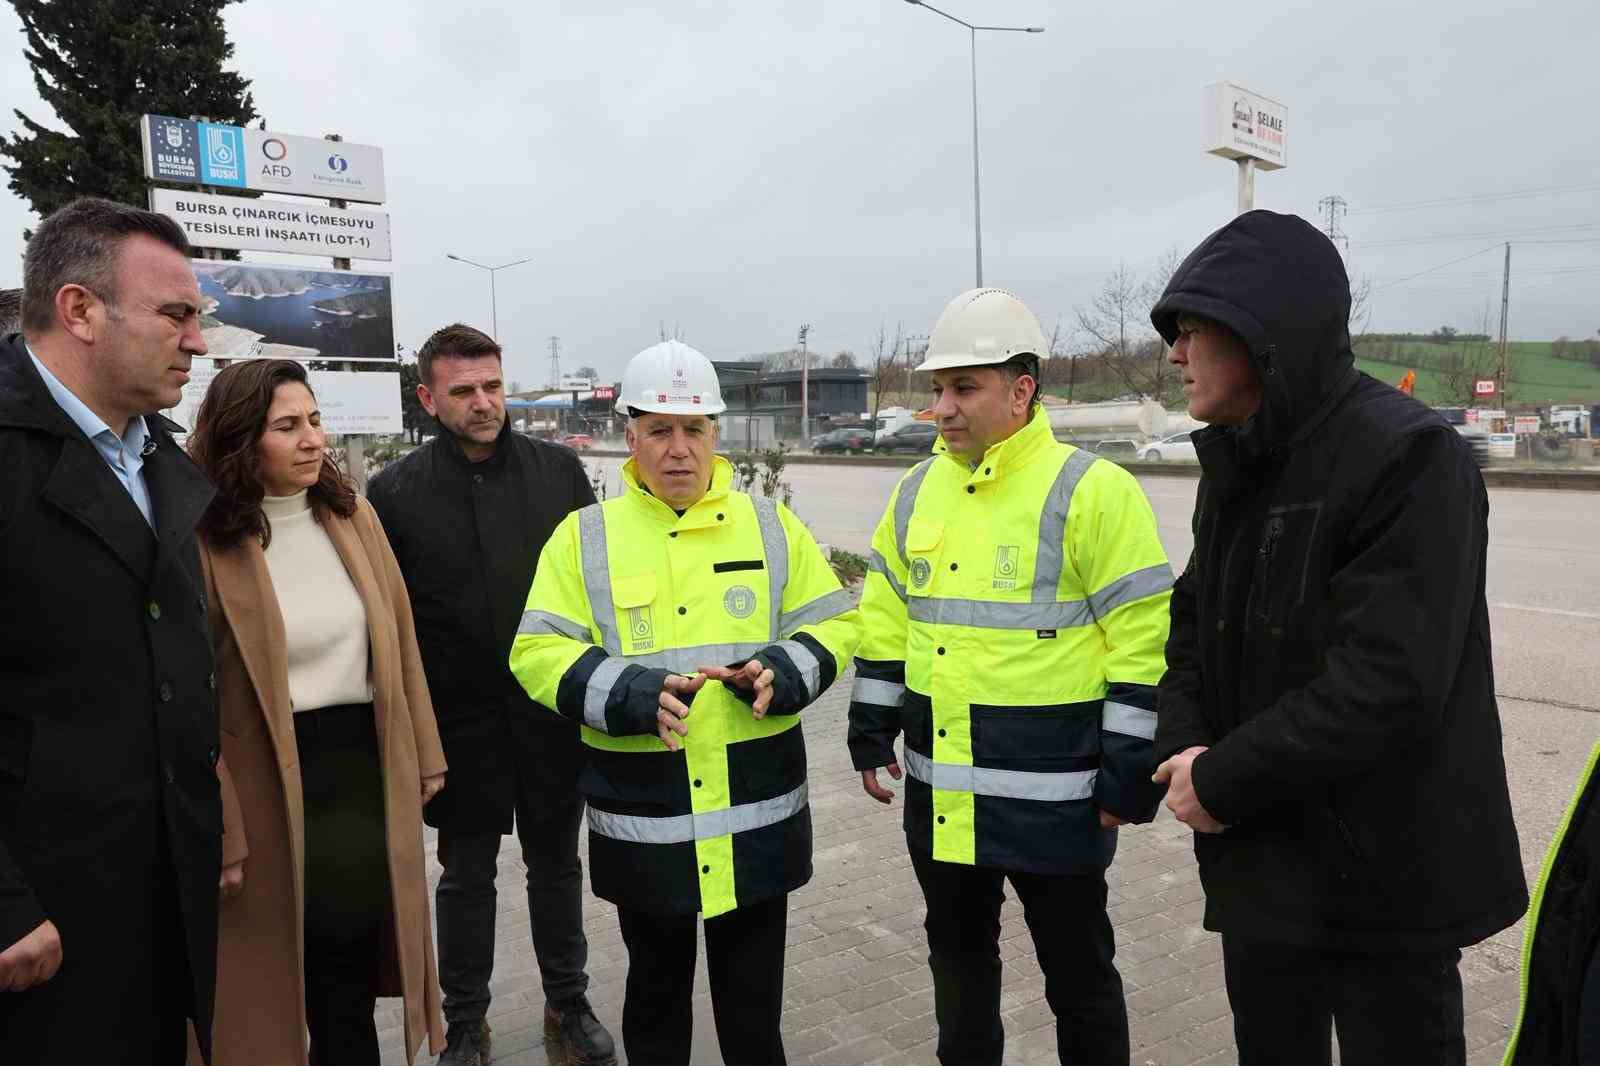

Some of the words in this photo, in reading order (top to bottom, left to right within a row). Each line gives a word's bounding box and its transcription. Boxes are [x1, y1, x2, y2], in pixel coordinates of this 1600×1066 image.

[158, 154, 194, 165] BURSA
[262, 164, 292, 178] AFD
[175, 201, 228, 216] BURSA
[232, 207, 301, 223] ÇINARCIK
[305, 212, 374, 230] İÇMESUYU
[184, 221, 260, 238] TESİSLERİ
[265, 226, 320, 242] İNŞAATI
[325, 233, 370, 249] (LOT-1)
